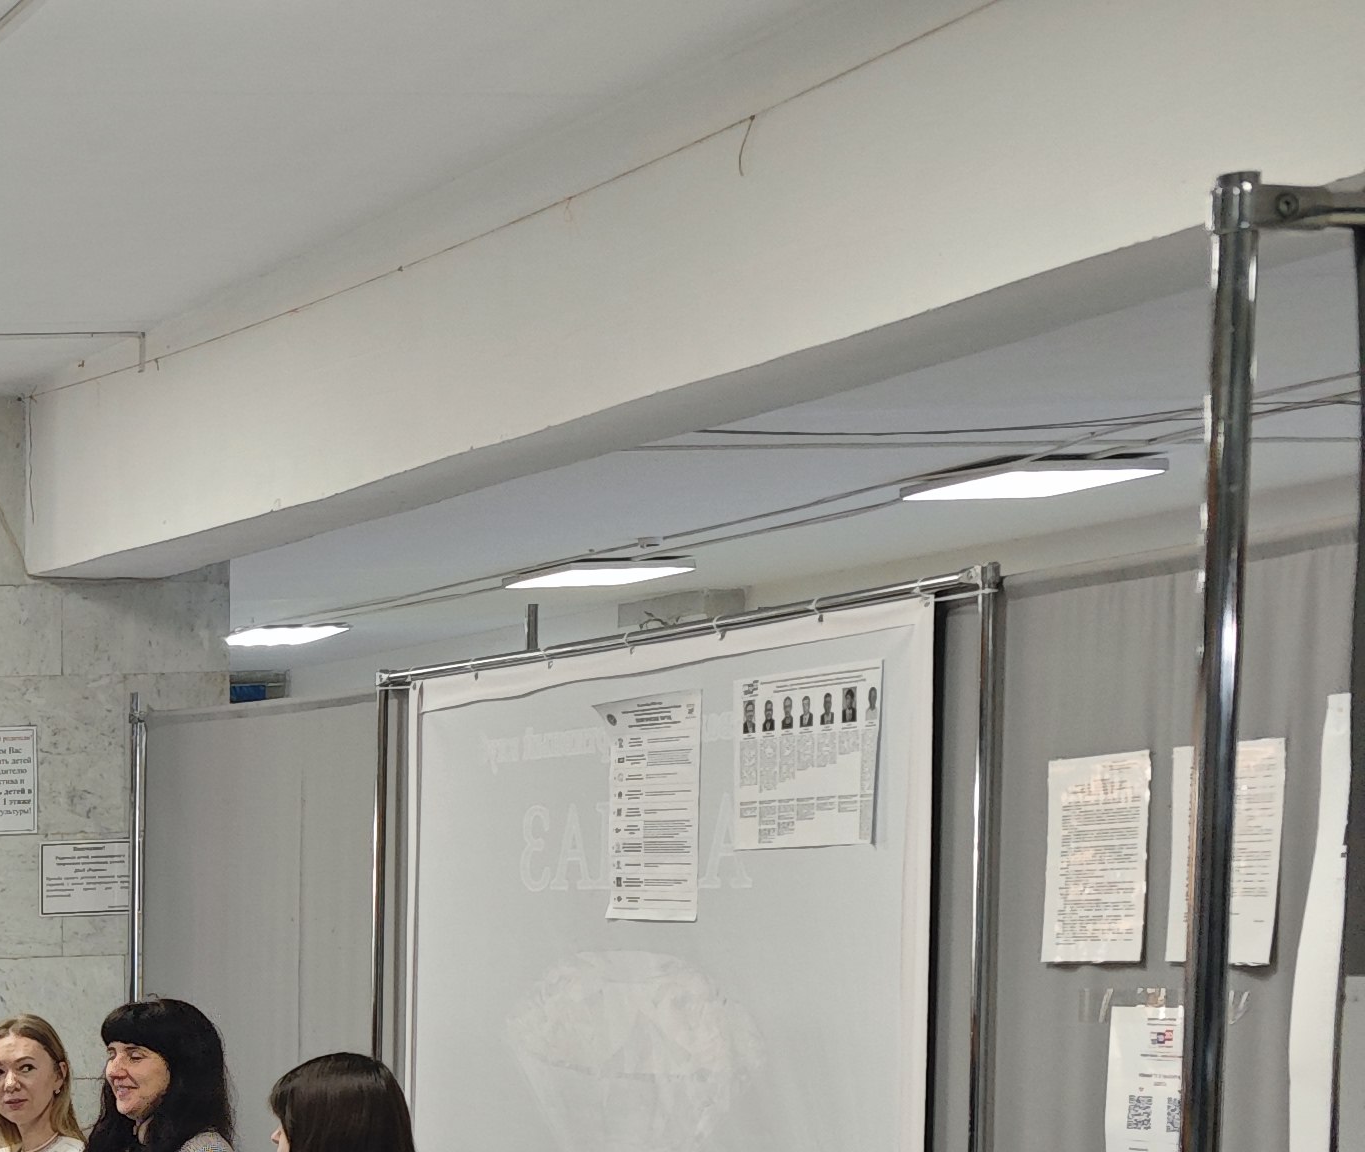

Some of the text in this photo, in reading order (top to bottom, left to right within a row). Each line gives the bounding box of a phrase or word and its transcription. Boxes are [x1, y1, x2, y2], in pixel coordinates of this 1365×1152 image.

[9, 746, 22, 755] Вас
[11, 757, 32, 765] детей
[4, 788, 25, 796] детей
